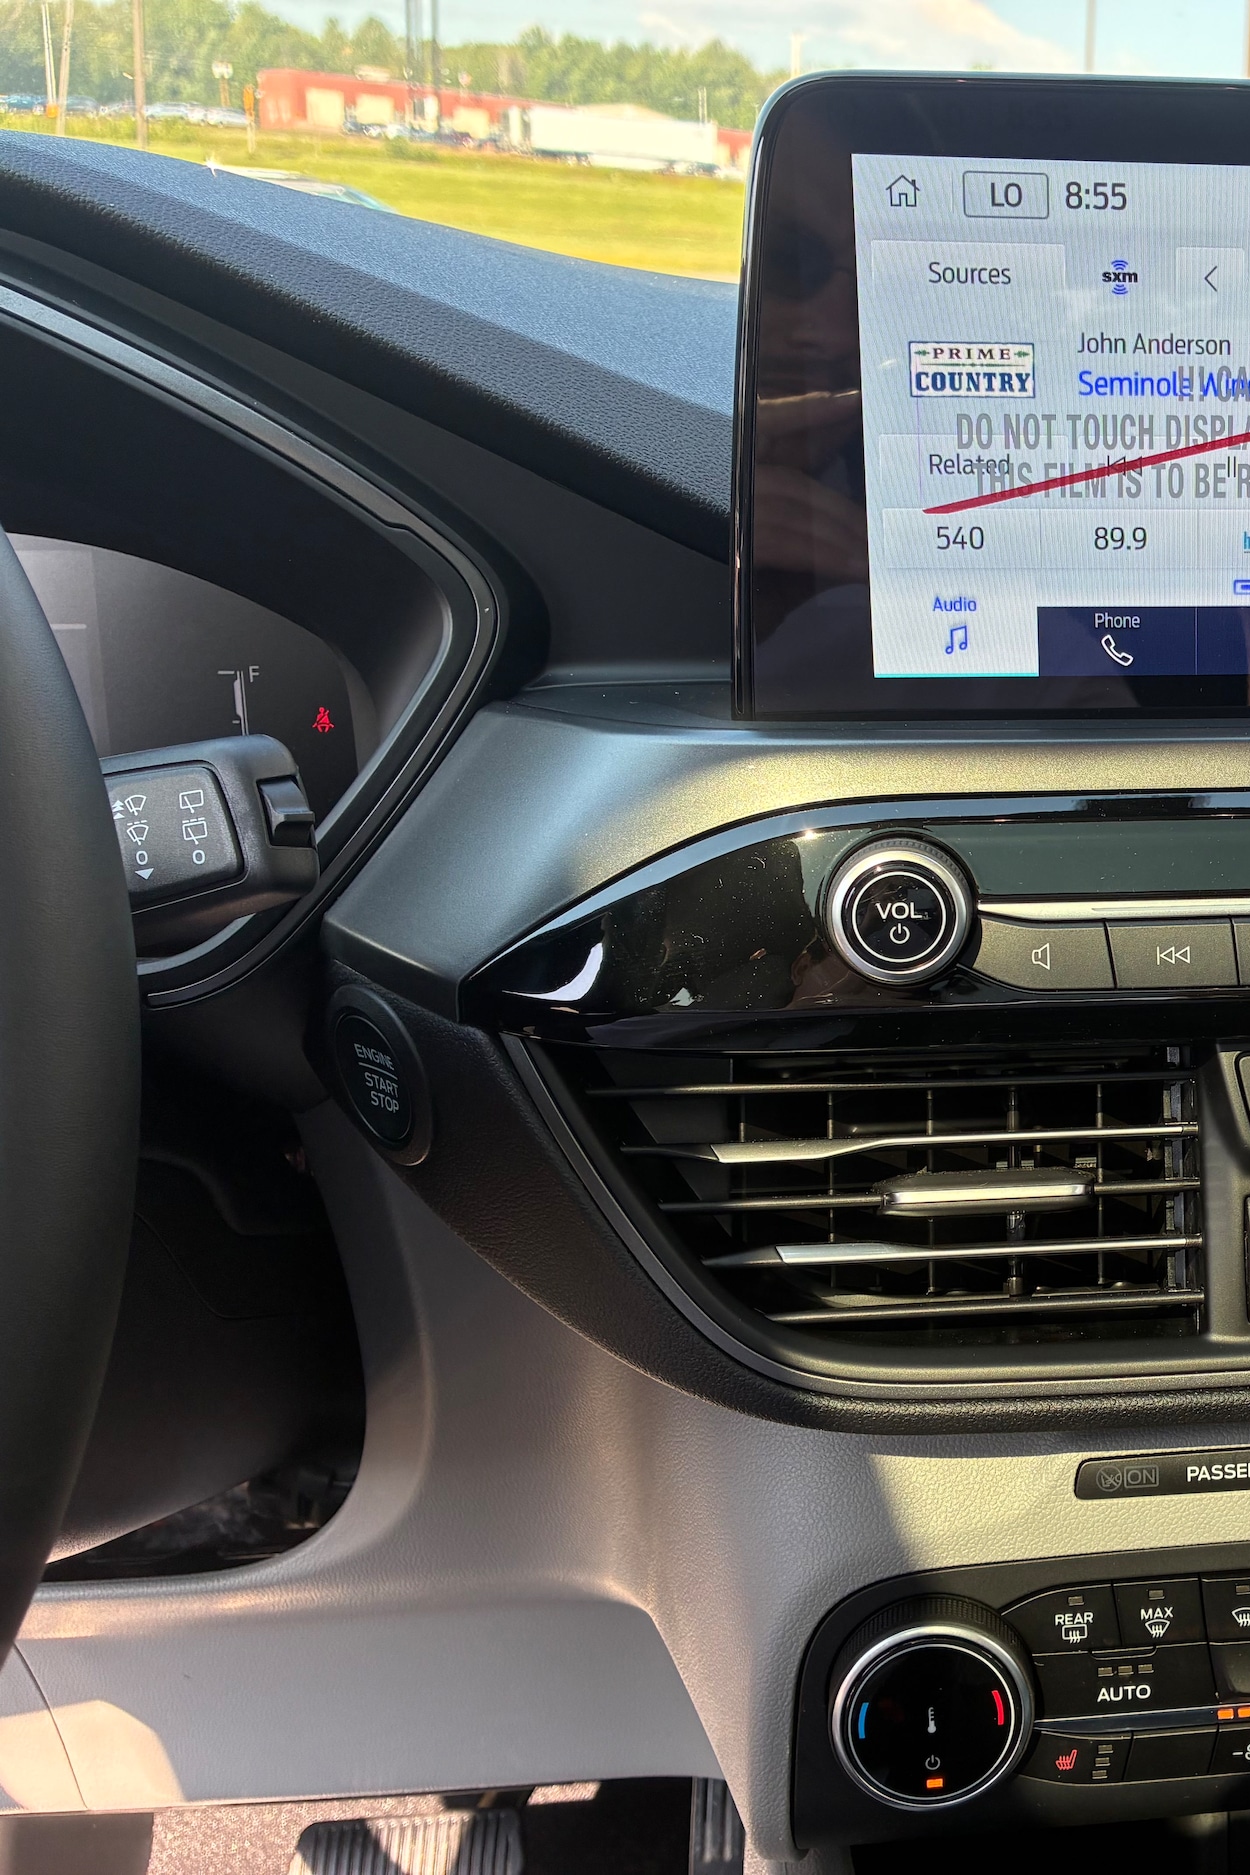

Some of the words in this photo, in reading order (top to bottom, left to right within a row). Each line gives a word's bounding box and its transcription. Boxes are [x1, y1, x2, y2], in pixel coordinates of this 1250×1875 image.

[990, 182, 1022, 207] LO
[1065, 181, 1127, 211] 8:55
[928, 261, 1012, 285] Sources
[932, 347, 1011, 360] PRIME
[1077, 332, 1126, 354] John
[1133, 333, 1231, 355] Anderson
[915, 371, 1031, 392] COUNTRY
[1078, 370, 1191, 397] Seminole
[956, 413, 993, 450] DO
[1003, 413, 1057, 450] NOT
[1067, 414, 1153, 451] TOUCH
[929, 453, 1010, 475] Related
[972, 462, 1032, 499] THIS
[1044, 462, 1107, 499] FILM
[1117, 462, 1141, 499] IS
[1155, 462, 1185, 499] TO
[1195, 463, 1229, 499] BE
[936, 526, 984, 550] 540
[1094, 526, 1147, 550] 89.9
[932, 596, 977, 613] Audio
[1094, 613, 1141, 629] Phone
[248, 665, 260, 683] F
[876, 901, 923, 921] VOL
[353, 1042, 395, 1071] ENGINE
[364, 1071, 399, 1098] START
[370, 1091, 400, 1114] STOP
[1126, 1467, 1156, 1485] ON
[1055, 1611, 1094, 1627] REAR
[1140, 1606, 1175, 1621] MAX
[1097, 1684, 1152, 1703] AUTO
